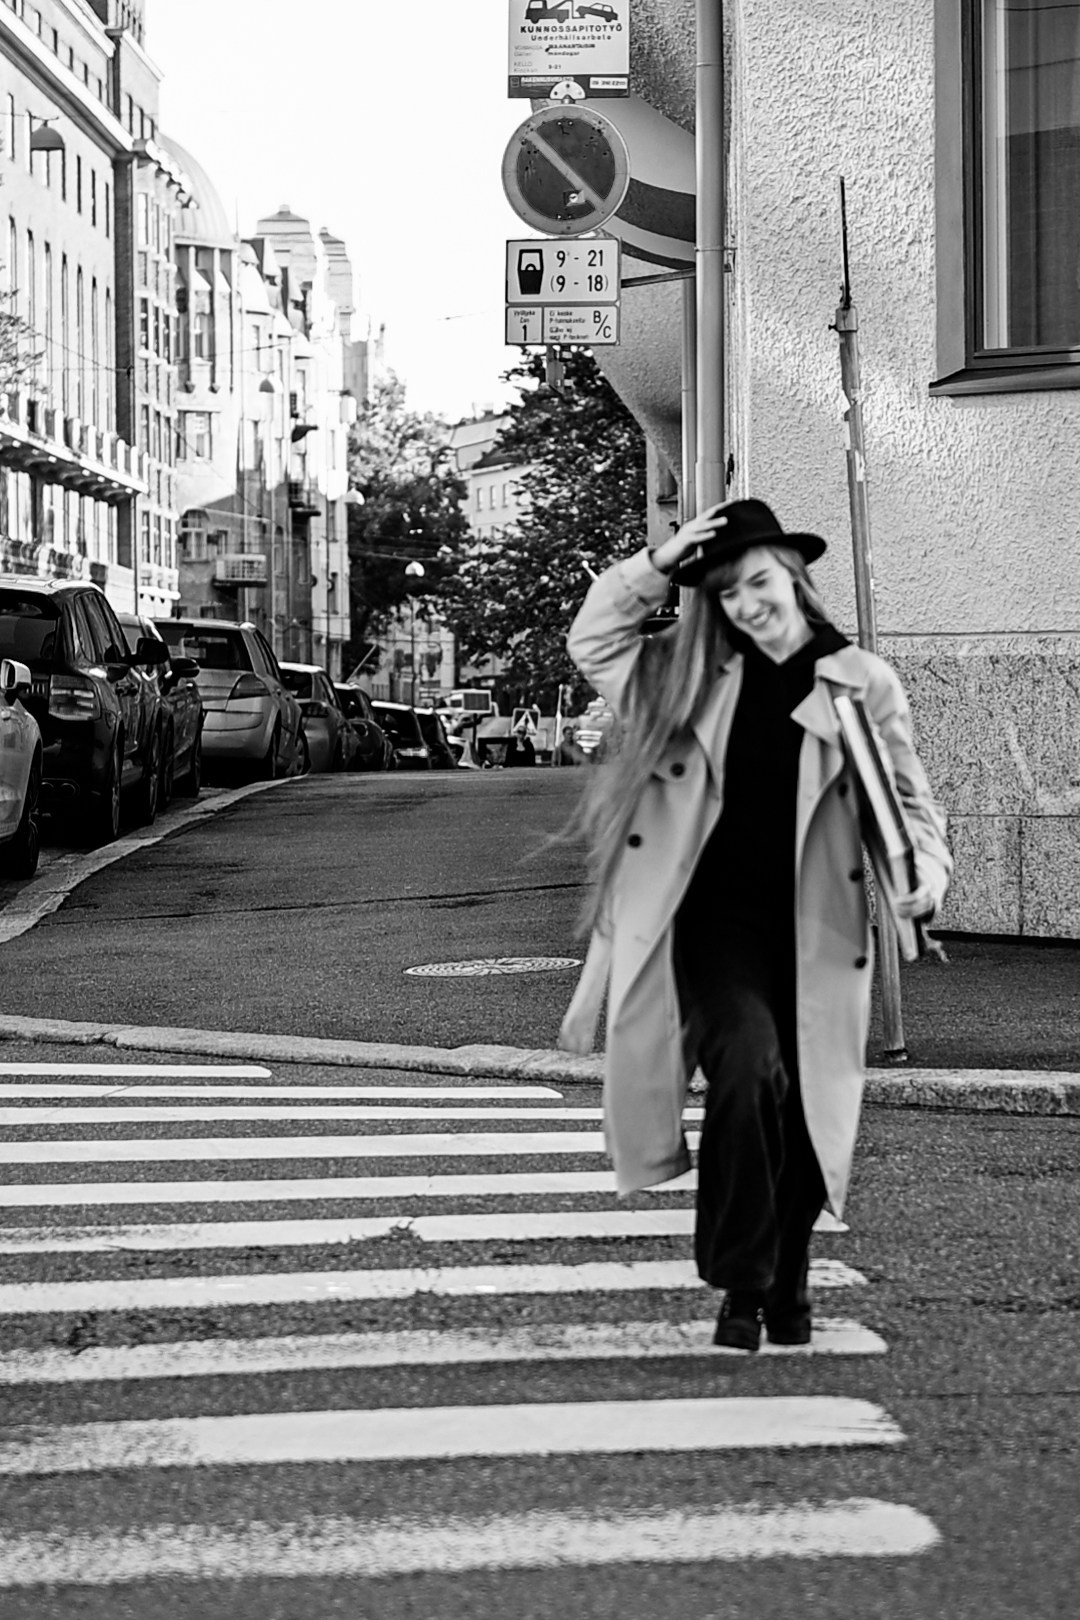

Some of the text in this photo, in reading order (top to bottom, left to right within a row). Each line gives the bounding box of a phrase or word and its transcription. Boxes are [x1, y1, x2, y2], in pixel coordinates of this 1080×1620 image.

[520, 23, 623, 33] KUNNOSSAPITOTYÖ
[556, 250, 566, 268] 9
[588, 250, 604, 267] 21
[550, 275, 566, 292] (9
[588, 274, 608, 292] 18)
[522, 324, 527, 341] 1
